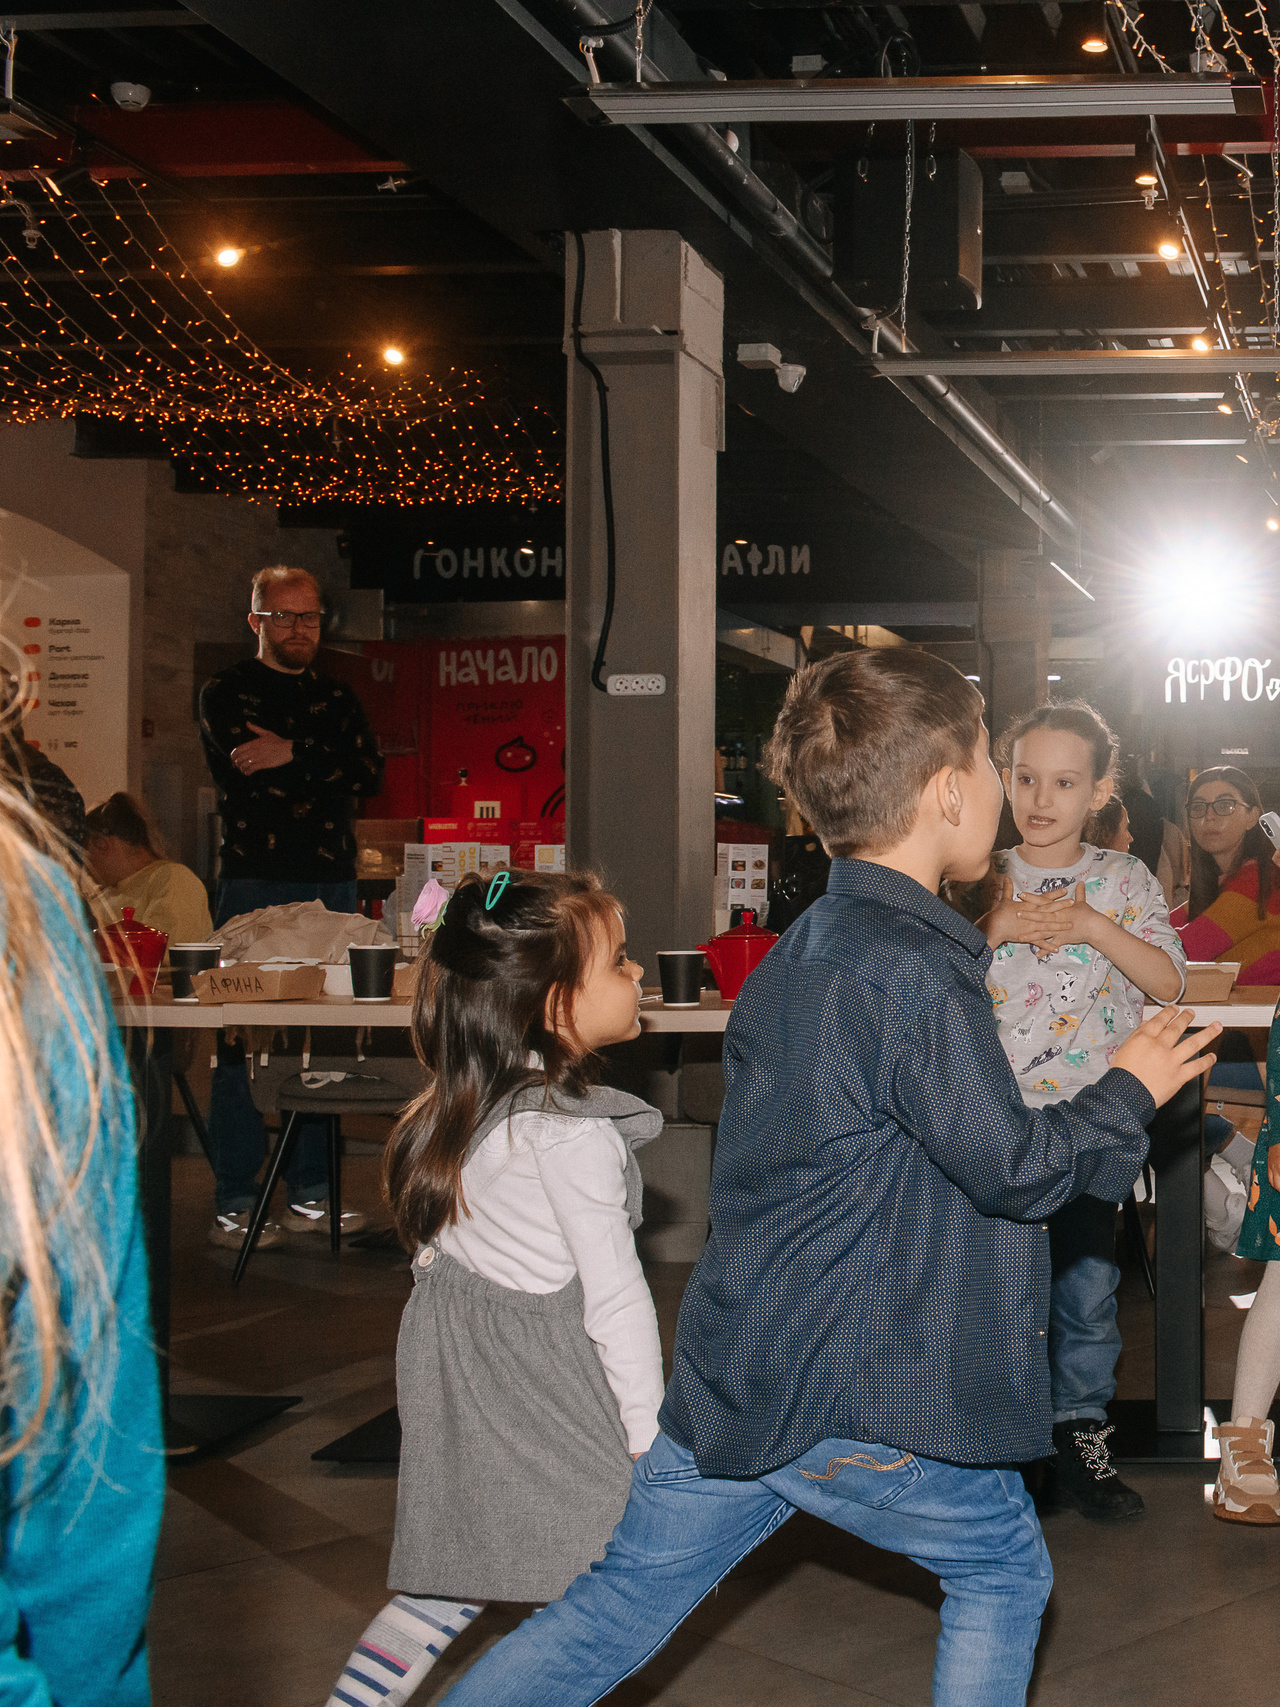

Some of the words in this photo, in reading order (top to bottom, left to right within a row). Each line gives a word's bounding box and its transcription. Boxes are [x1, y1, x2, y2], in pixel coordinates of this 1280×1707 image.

[412, 546, 564, 579] ГОНКОН
[721, 543, 811, 577] АФЛИ
[210, 975, 264, 996] АФИНА
